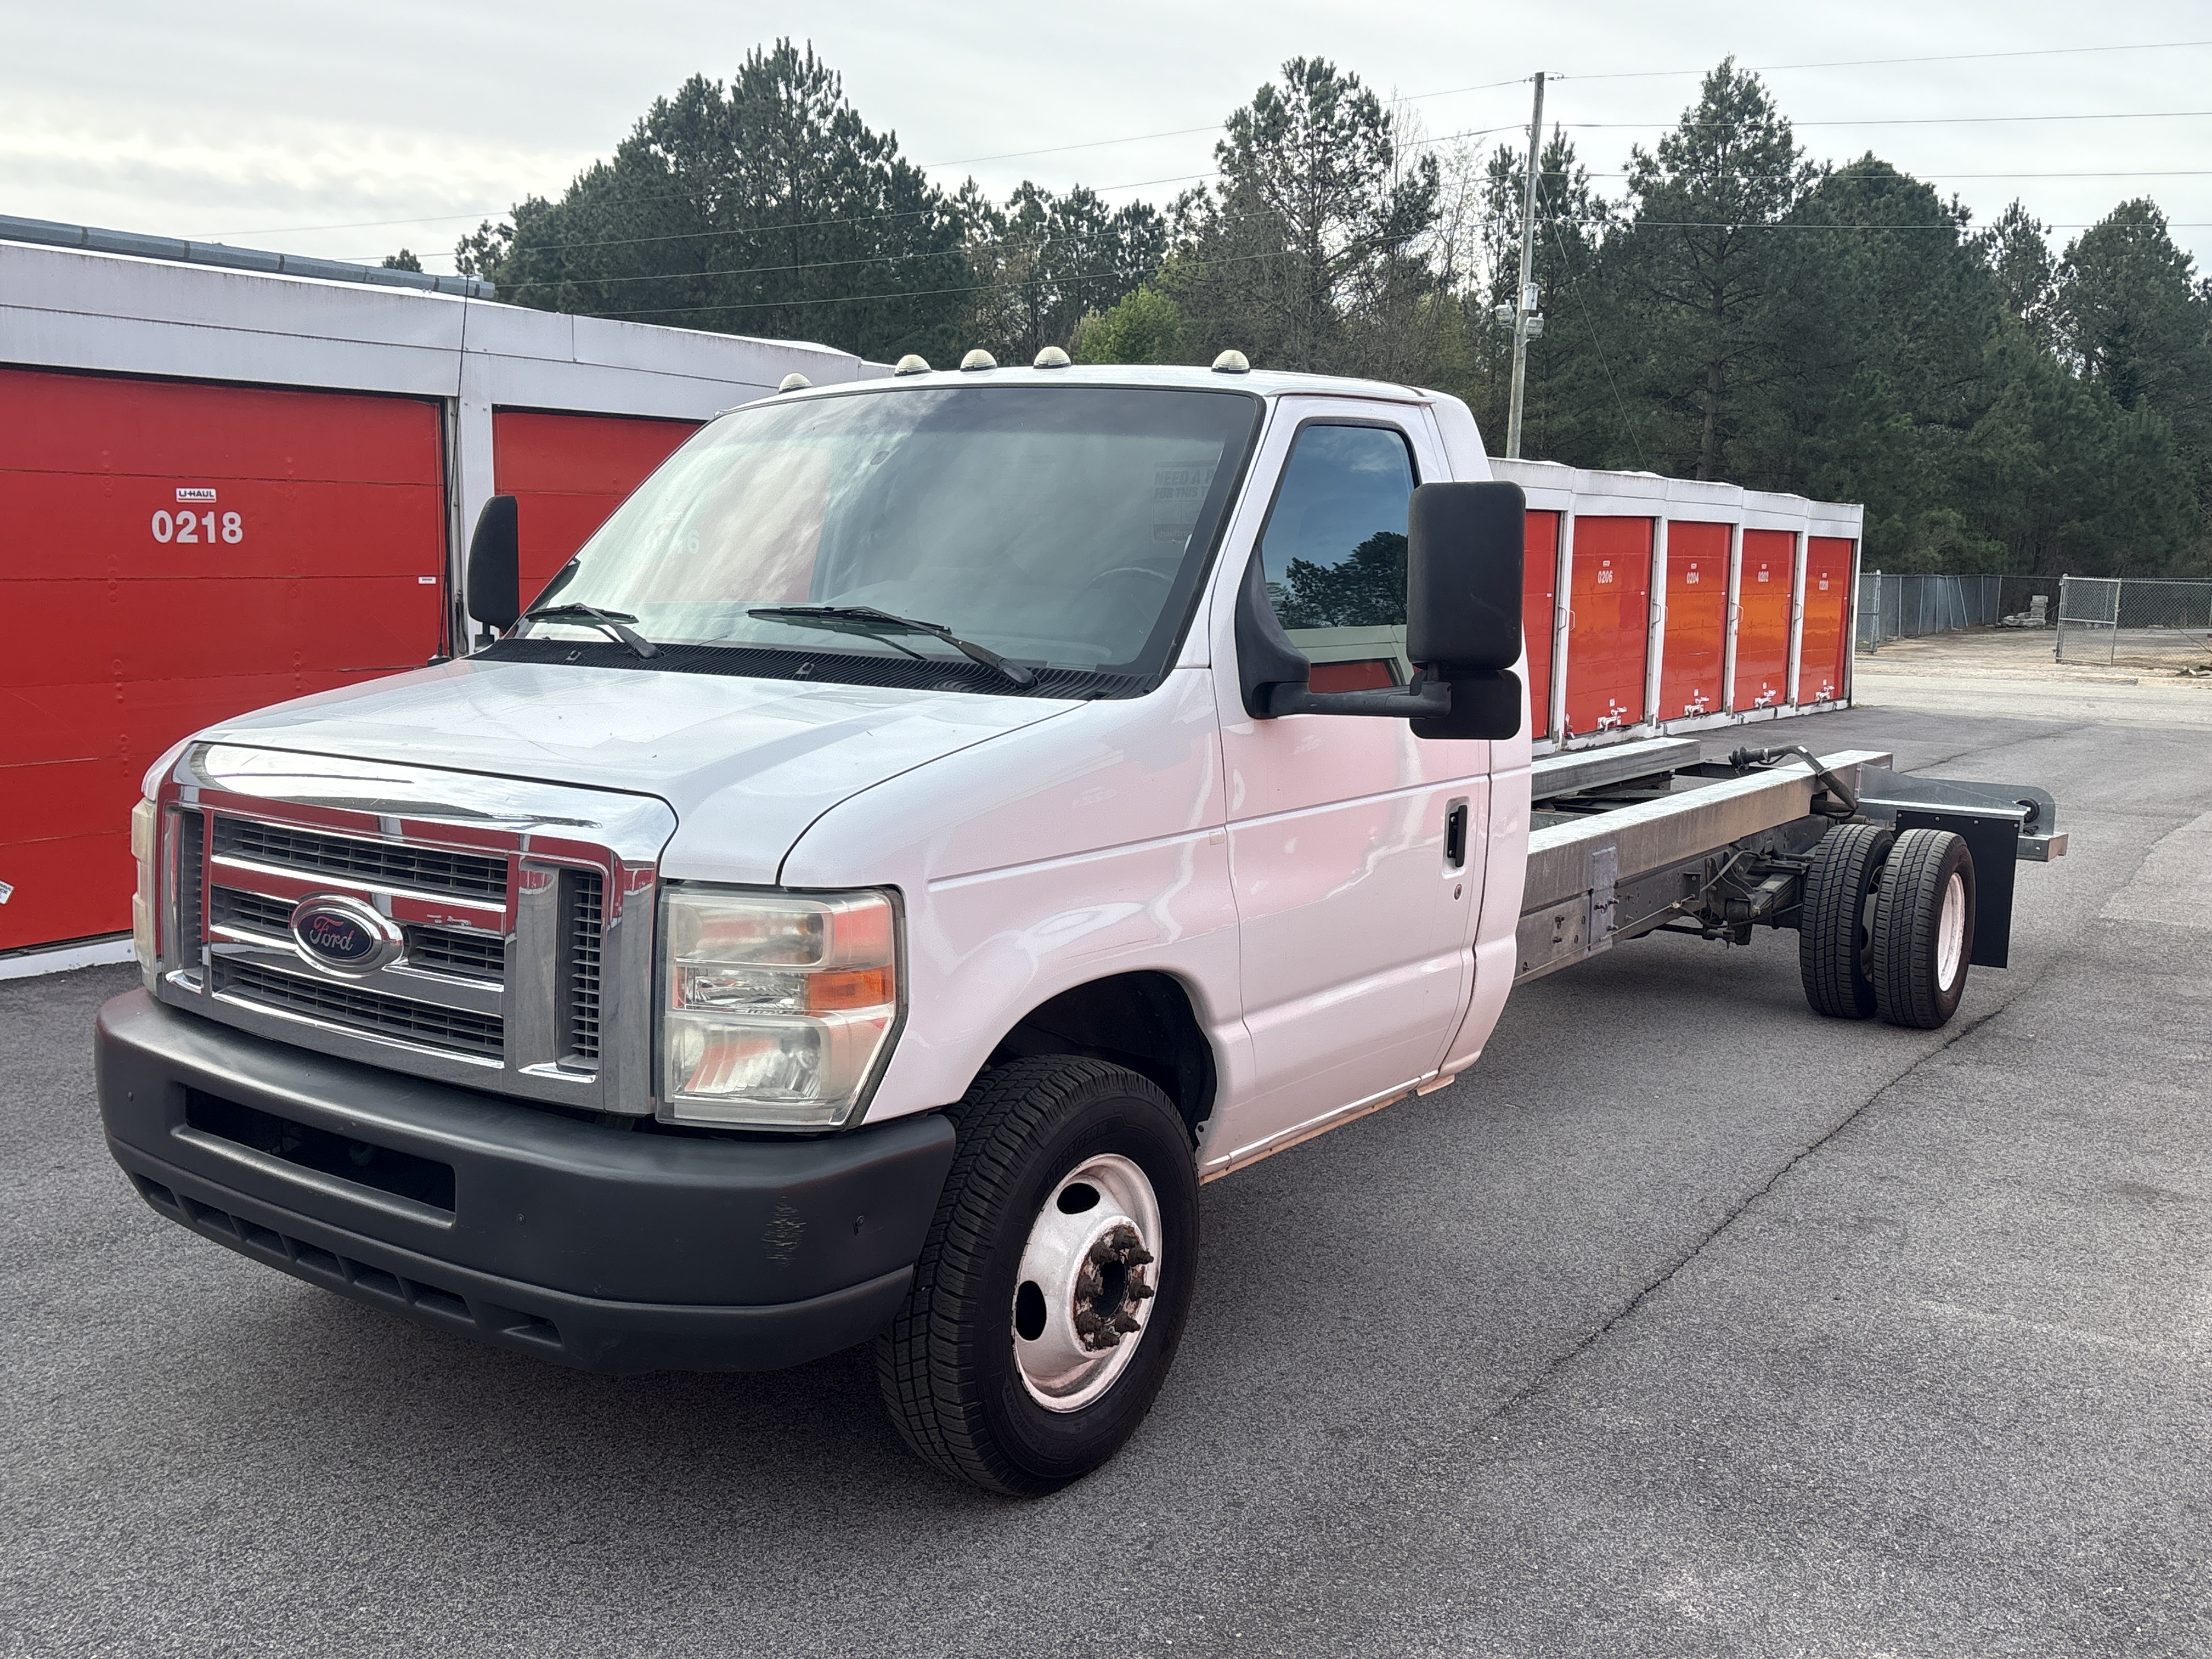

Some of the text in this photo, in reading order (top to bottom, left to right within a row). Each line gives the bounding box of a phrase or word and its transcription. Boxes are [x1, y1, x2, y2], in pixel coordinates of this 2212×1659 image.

[1154, 471, 1189, 486] NEED
[1191, 470, 1201, 484] A
[1154, 488, 1173, 499] FOR
[1176, 487, 1198, 498] THIS
[151, 510, 243, 544] 0218
[1598, 570, 1613, 584] 0206
[1686, 572, 1699, 584] 0204
[309, 916, 354, 951] Ford
